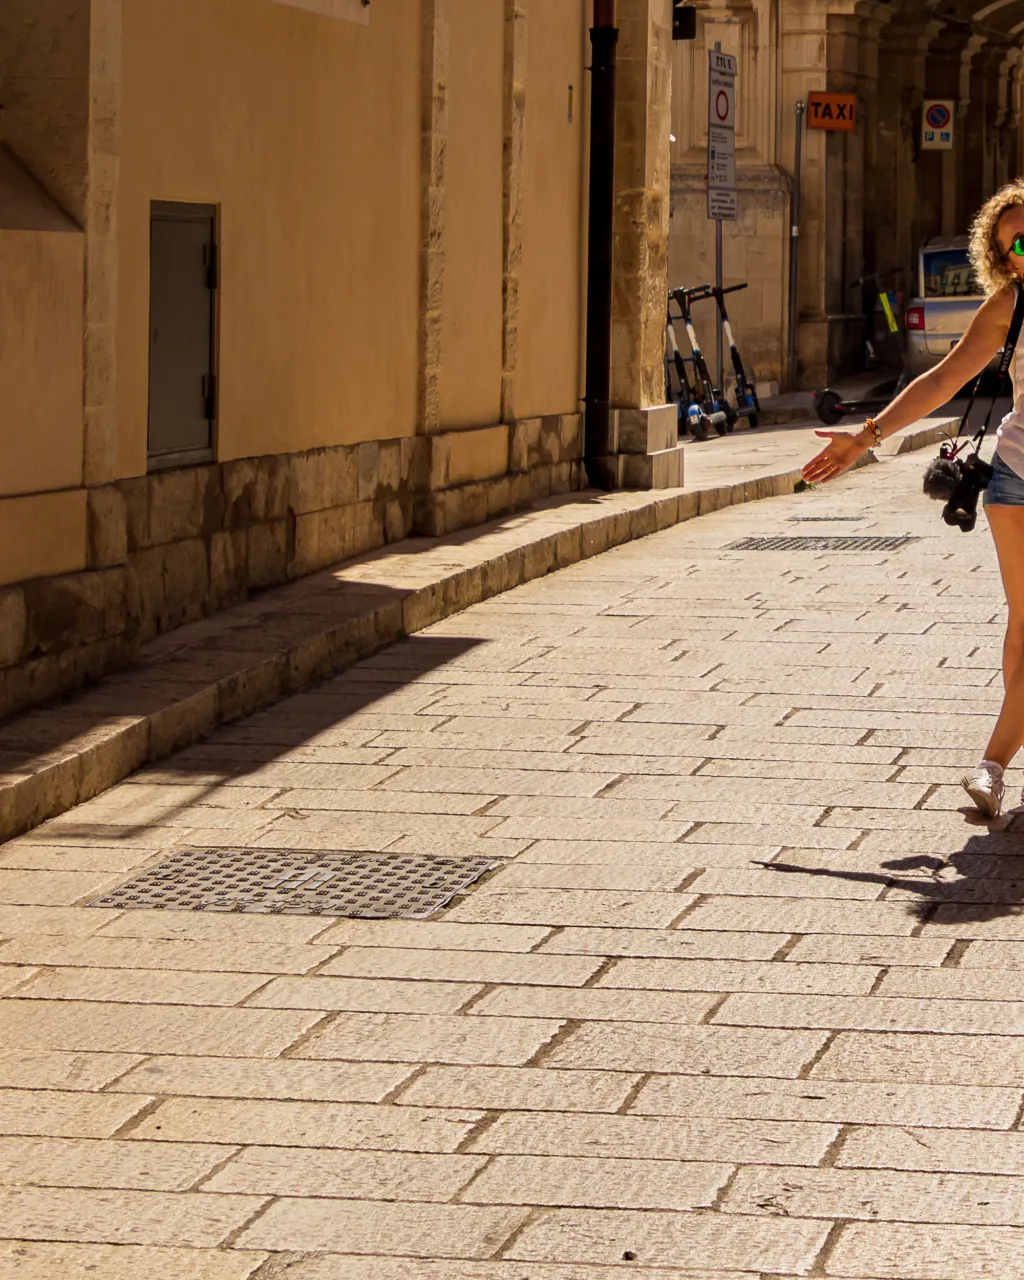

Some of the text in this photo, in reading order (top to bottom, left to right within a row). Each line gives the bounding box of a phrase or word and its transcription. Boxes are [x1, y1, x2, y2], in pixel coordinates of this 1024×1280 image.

[715, 55, 727, 69] ZTL
[811, 101, 854, 121] TAXI
[1000, 342, 1014, 372] SONY
